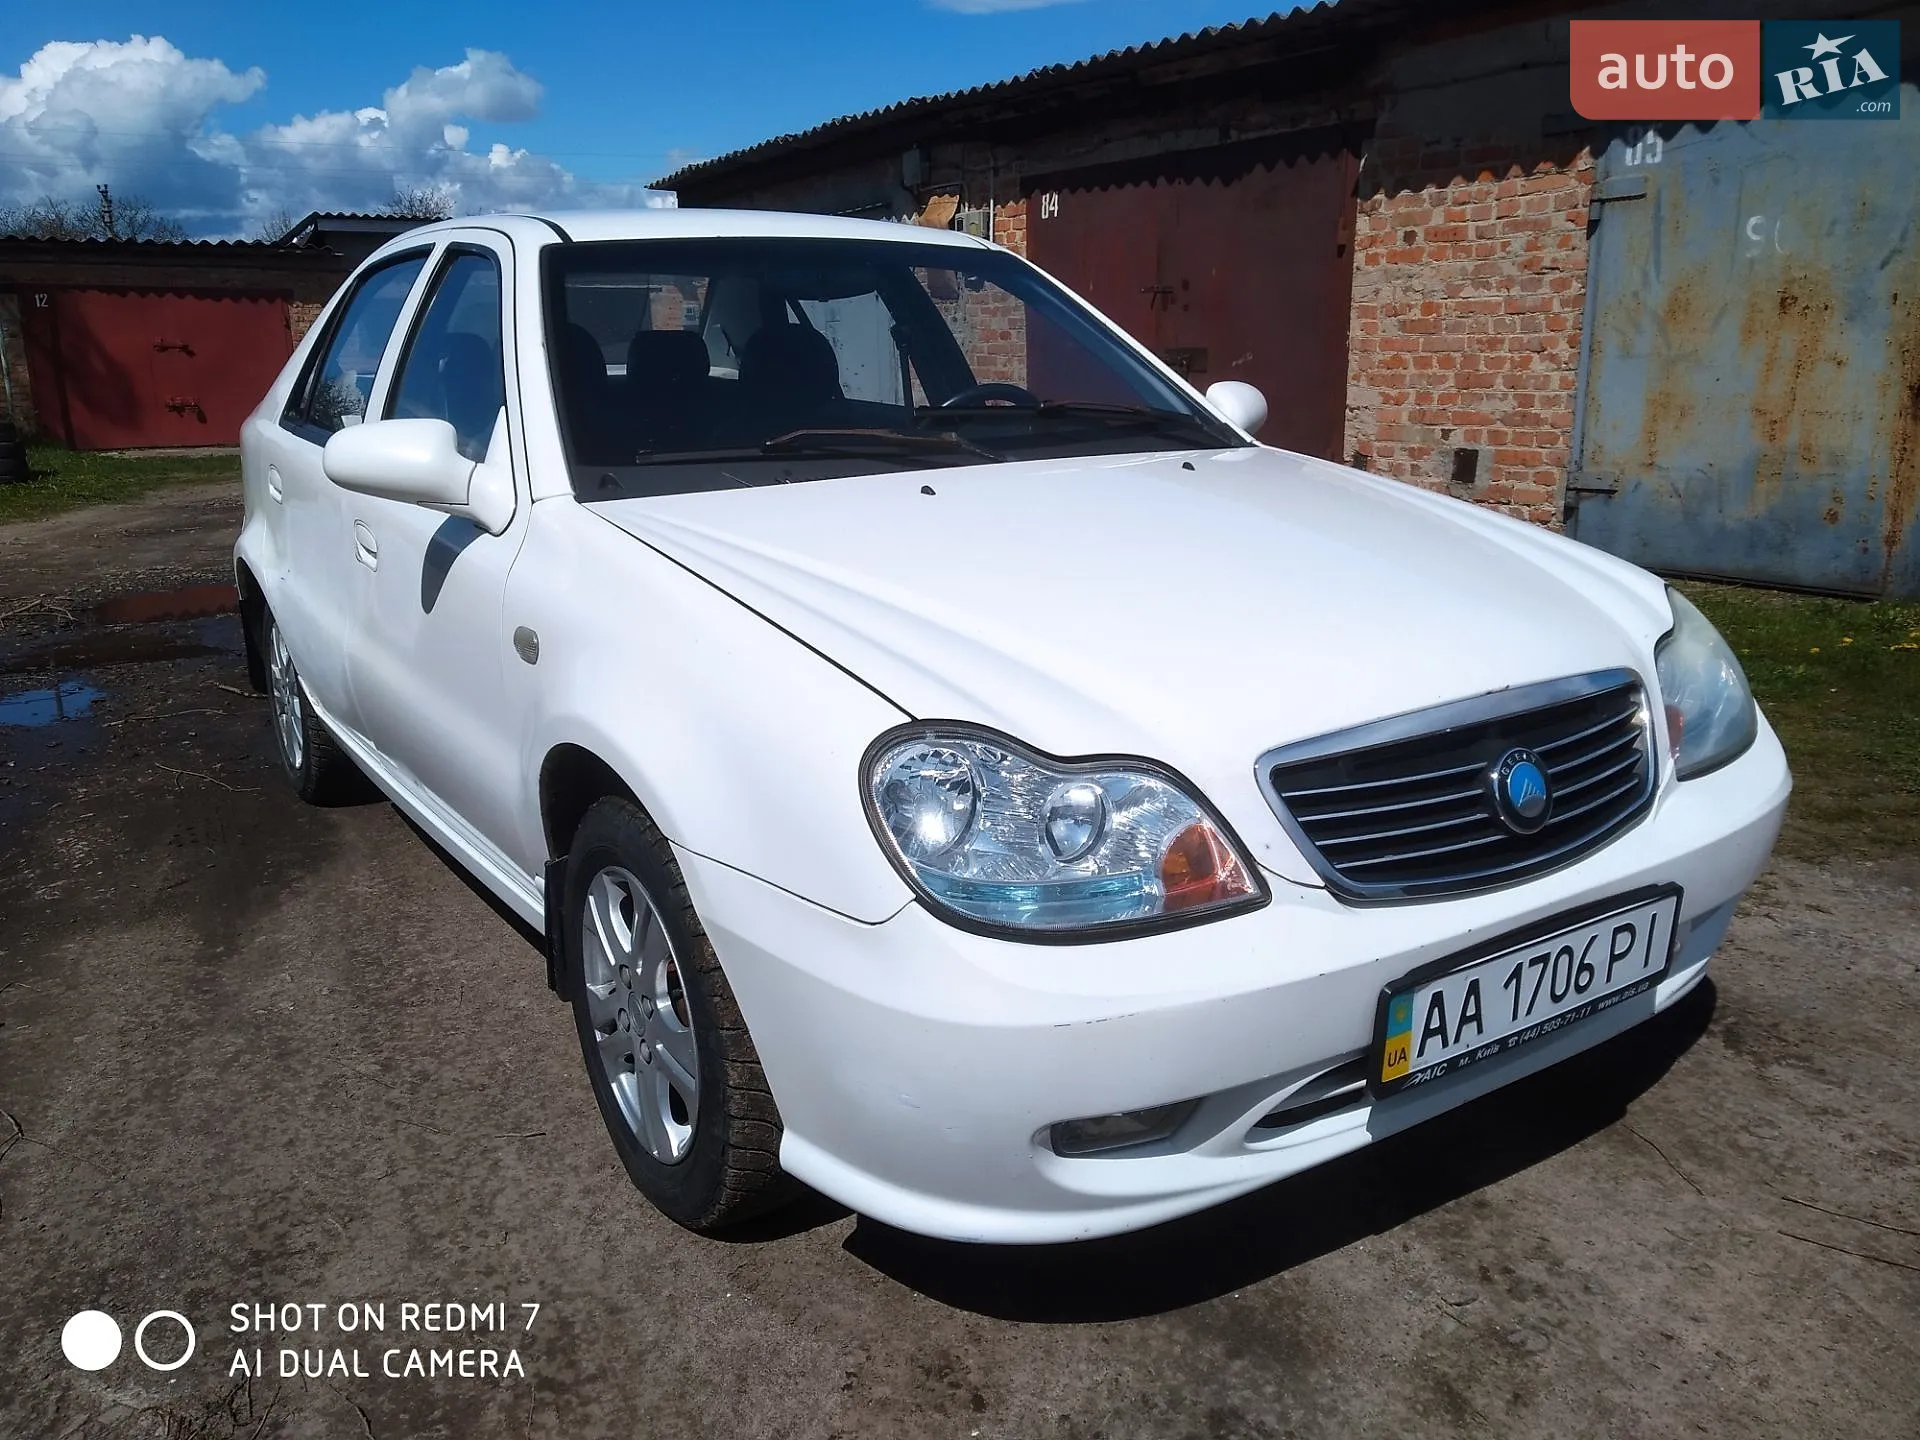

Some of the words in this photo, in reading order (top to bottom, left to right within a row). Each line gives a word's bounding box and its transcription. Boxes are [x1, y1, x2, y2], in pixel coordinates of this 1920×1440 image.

[1042, 192, 1058, 219] 84
[35, 293, 48, 307] 12
[1417, 978, 1483, 1058] AA
[1503, 933, 1599, 1022] 1706
[1520, 1025, 1541, 1044] (44)
[1387, 1047, 1408, 1068] UA
